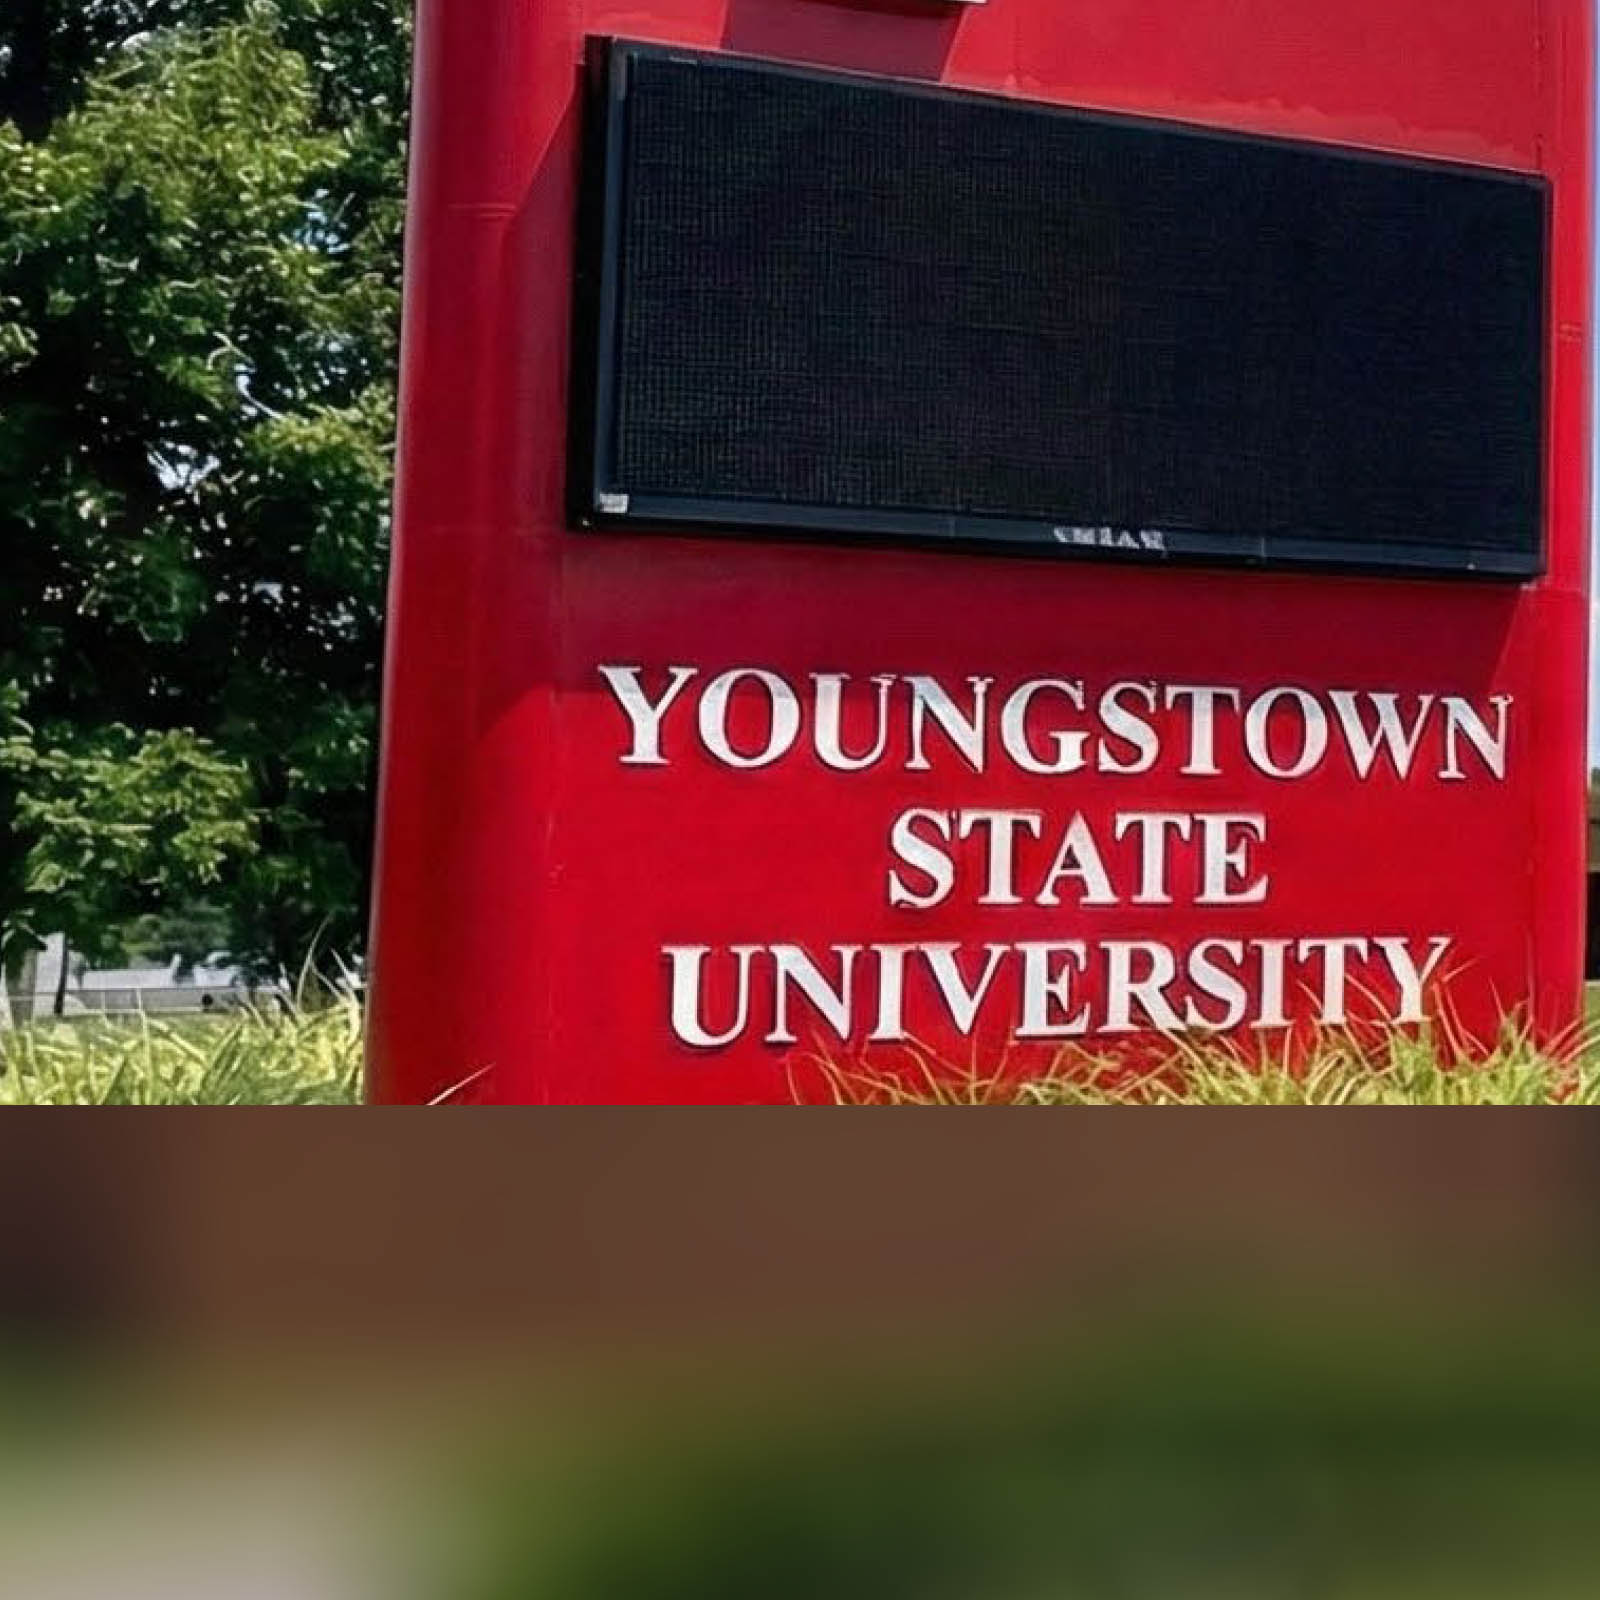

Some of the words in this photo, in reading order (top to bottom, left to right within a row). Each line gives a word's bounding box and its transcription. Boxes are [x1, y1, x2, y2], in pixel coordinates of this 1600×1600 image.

[597, 663, 1515, 781] YOUNGSTOWN
[887, 807, 1269, 909] STATE
[661, 936, 1452, 1048] UNIVERSITY
